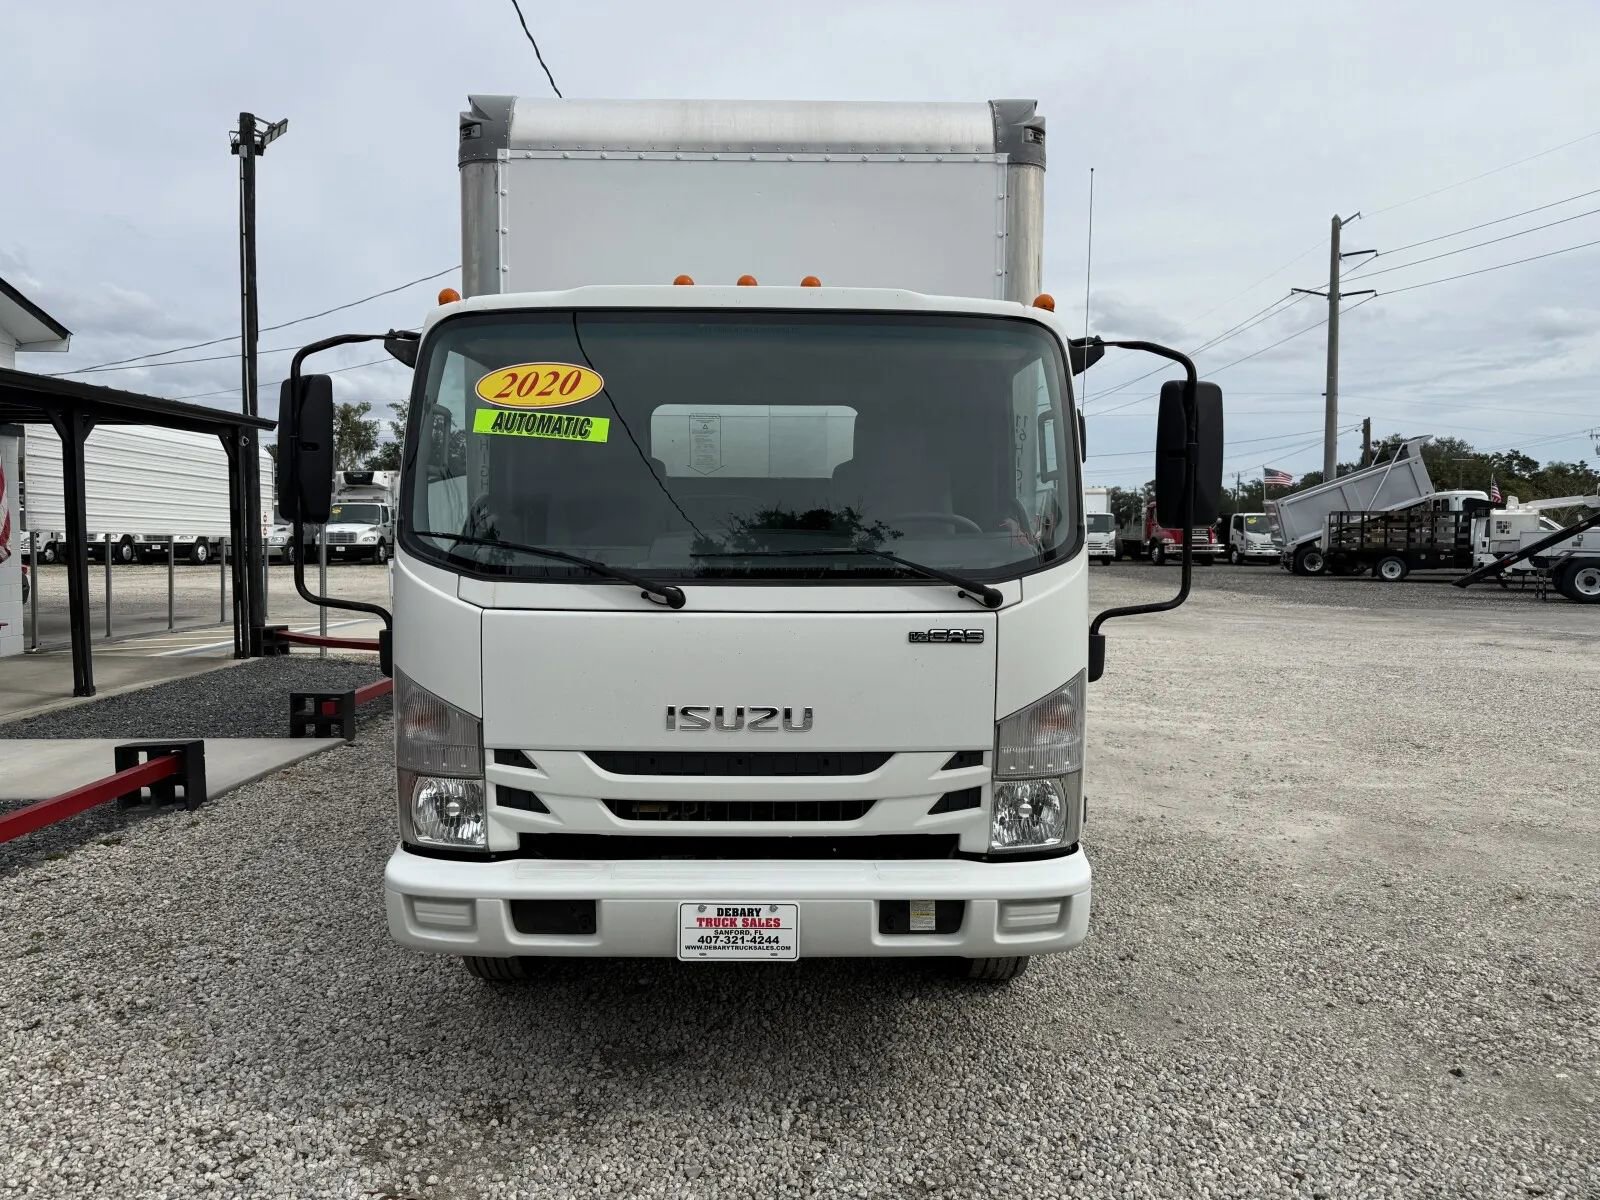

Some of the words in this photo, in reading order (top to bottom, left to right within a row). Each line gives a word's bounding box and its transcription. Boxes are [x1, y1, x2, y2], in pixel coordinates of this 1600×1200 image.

[493, 369, 582, 399] 2020
[491, 411, 593, 439] AUTOMATIC
[666, 704, 813, 732] ISUZU
[716, 907, 762, 917] DEBARY
[696, 917, 738, 928] TRUCK
[741, 917, 781, 928] SALES
[714, 929, 752, 937] SANFORD,
[697, 936, 780, 944] 407-321-4244
